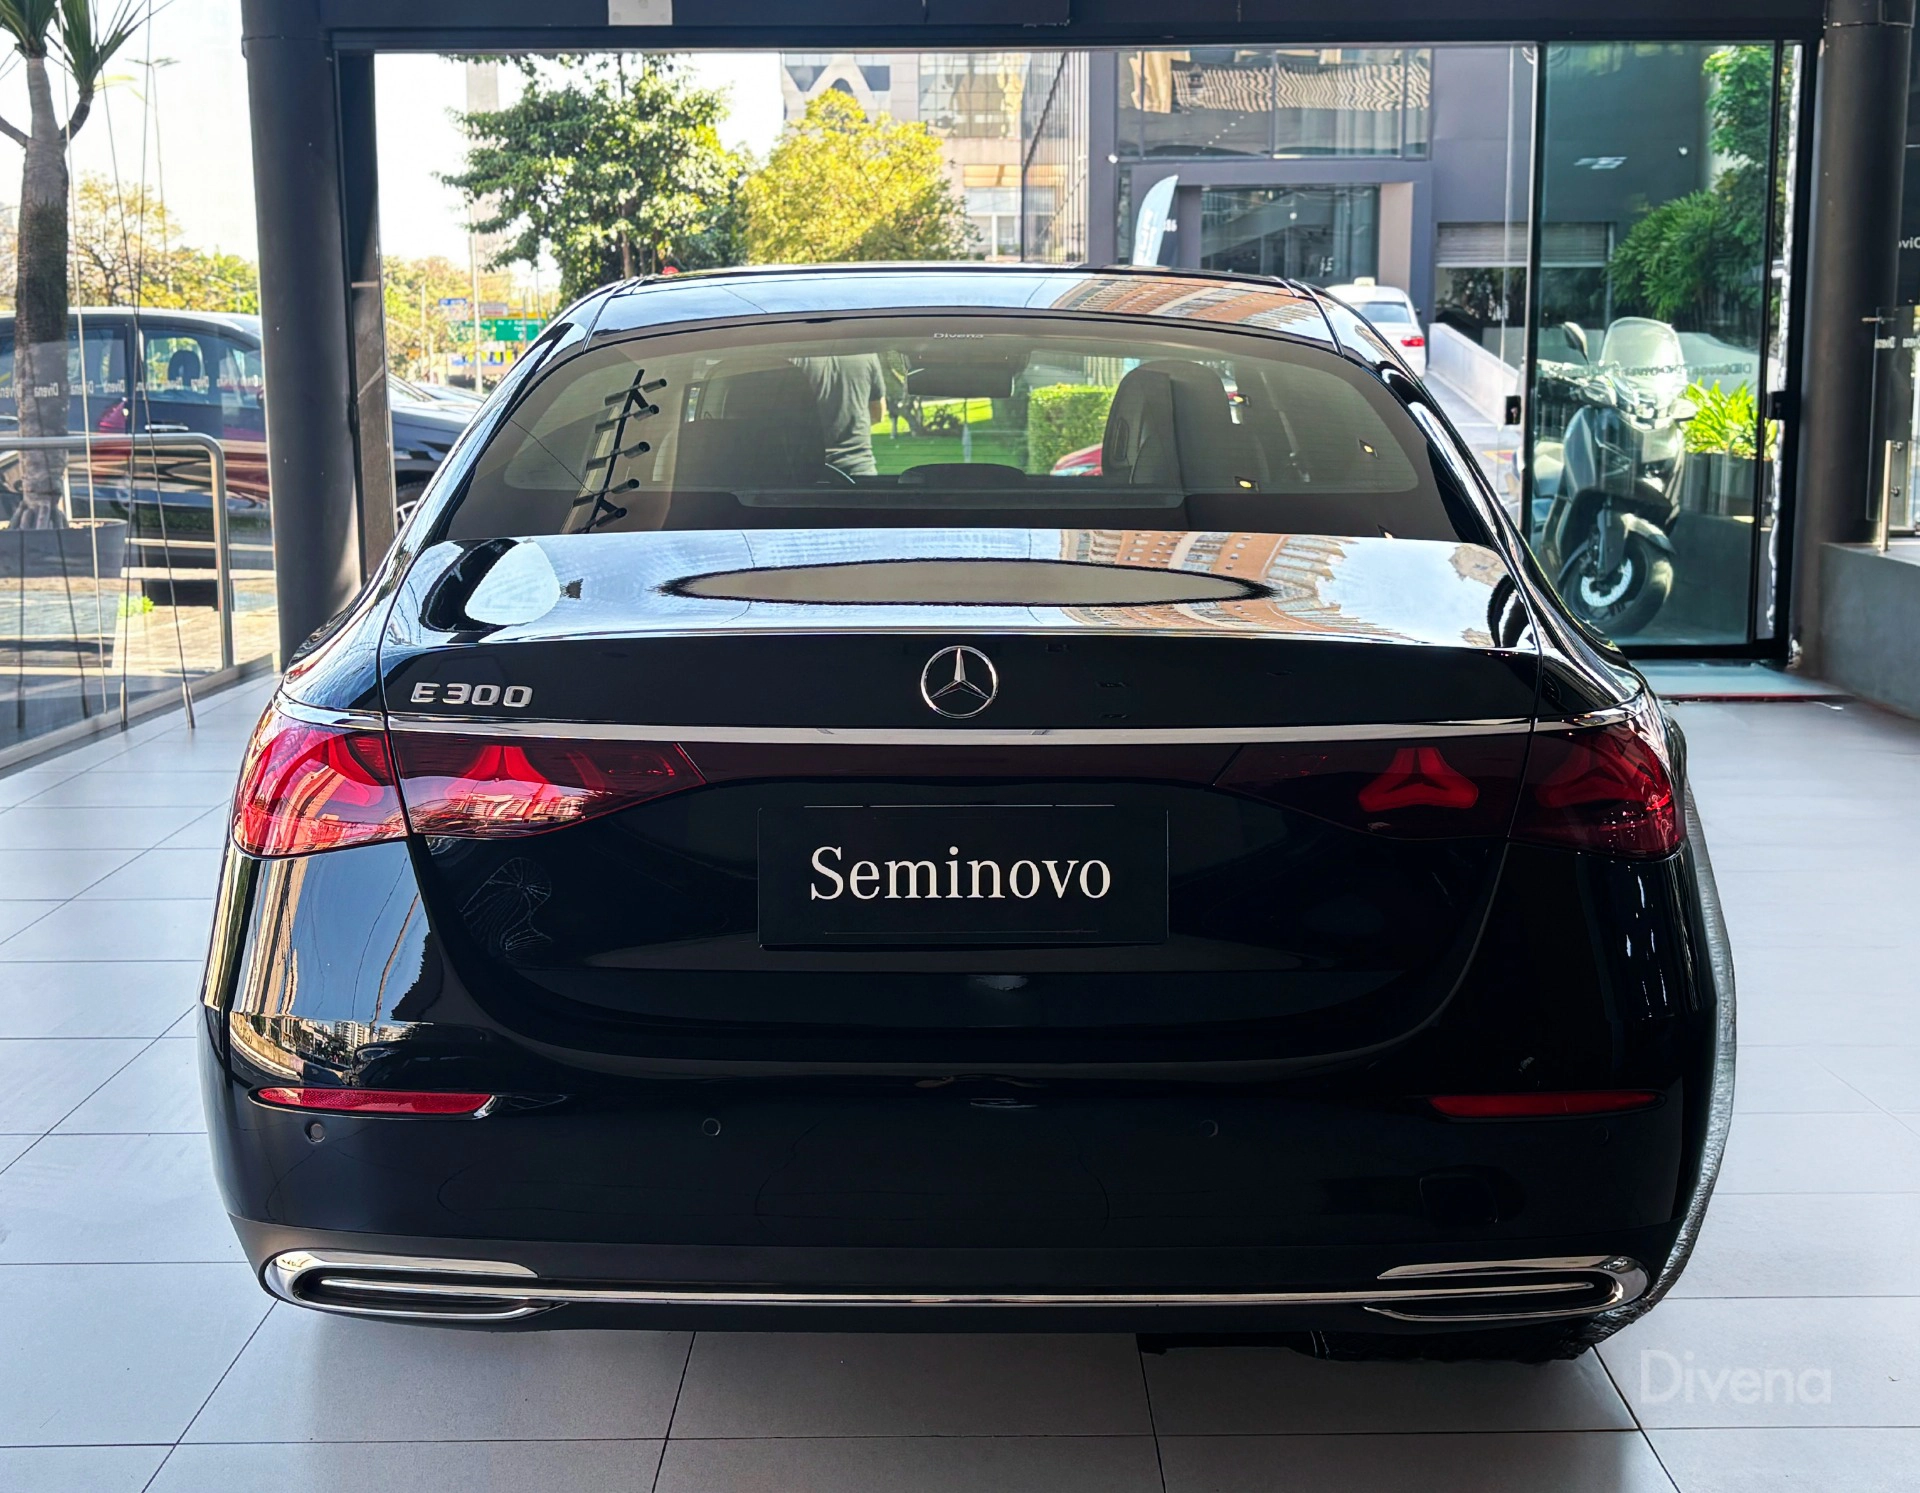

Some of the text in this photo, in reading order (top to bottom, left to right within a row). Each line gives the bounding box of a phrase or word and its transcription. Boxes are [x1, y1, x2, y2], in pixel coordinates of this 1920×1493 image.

[410, 682, 533, 708] E 300
[811, 845, 1111, 900] Seminovo
